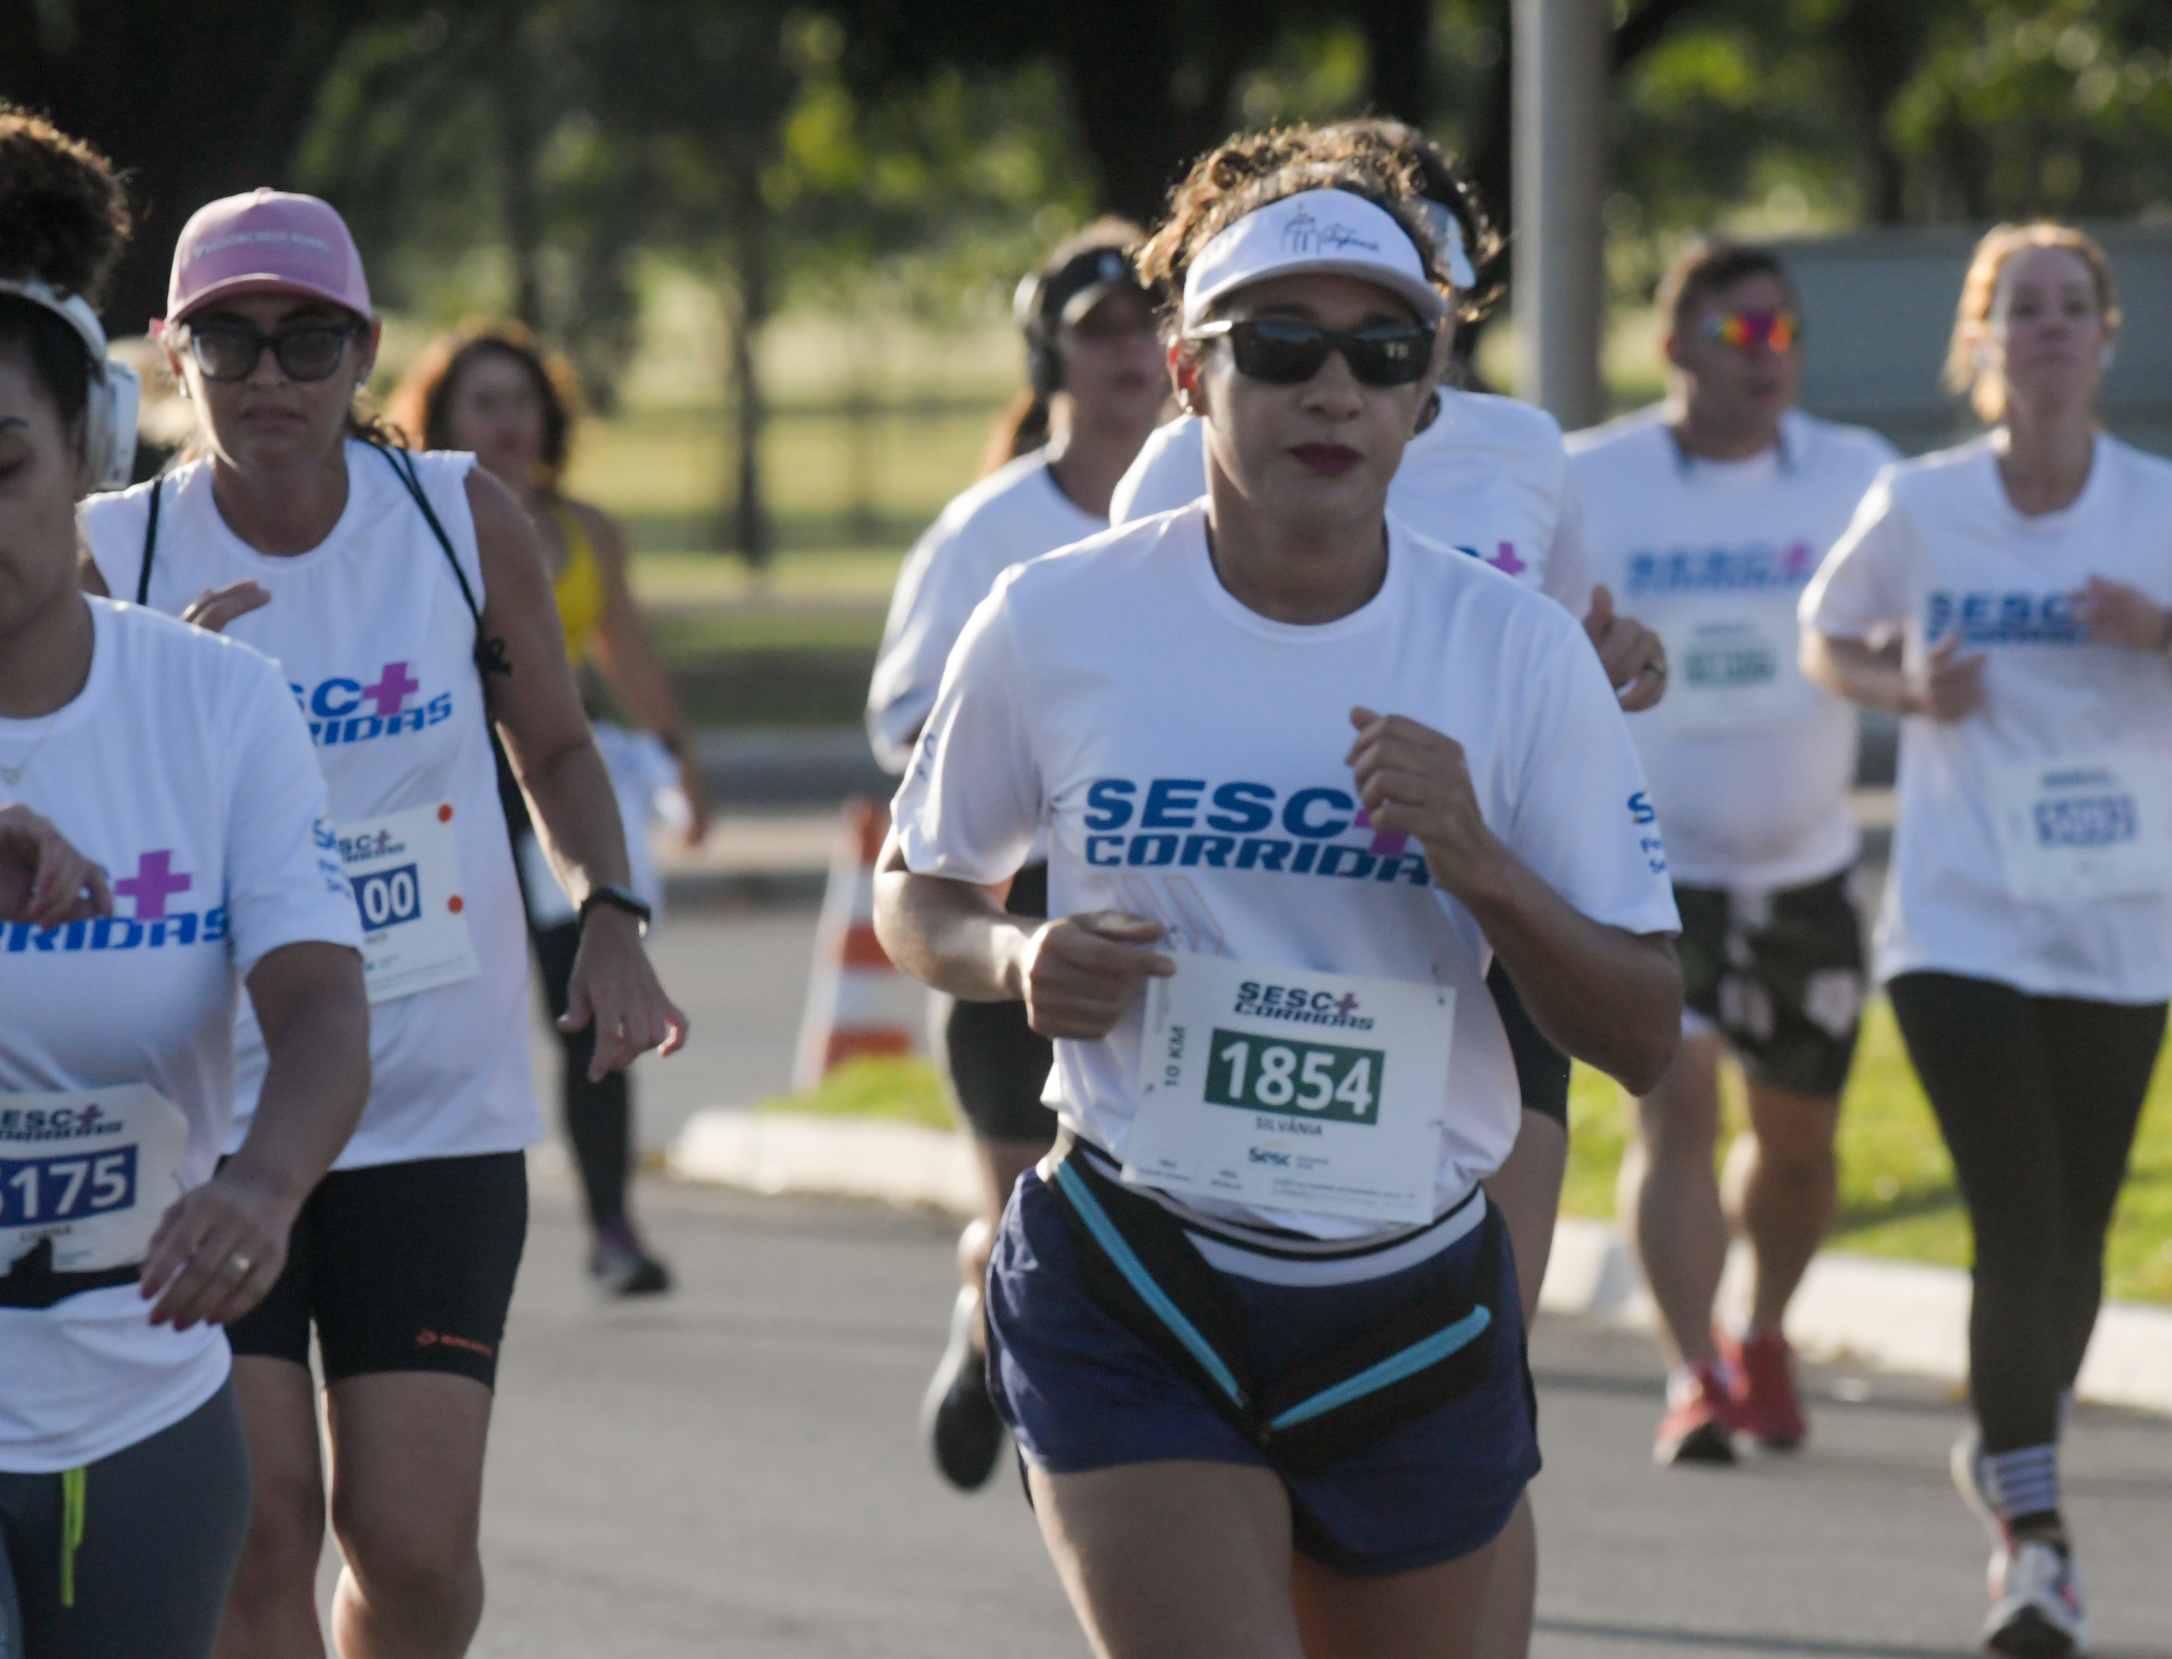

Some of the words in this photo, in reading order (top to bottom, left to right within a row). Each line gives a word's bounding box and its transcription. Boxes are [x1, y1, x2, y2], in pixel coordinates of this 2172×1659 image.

[1168, 1025, 1186, 1059] KM
[1163, 1065, 1181, 1086] 10
[1220, 1040, 1373, 1116] 1854
[0, 1153, 128, 1219] 175
